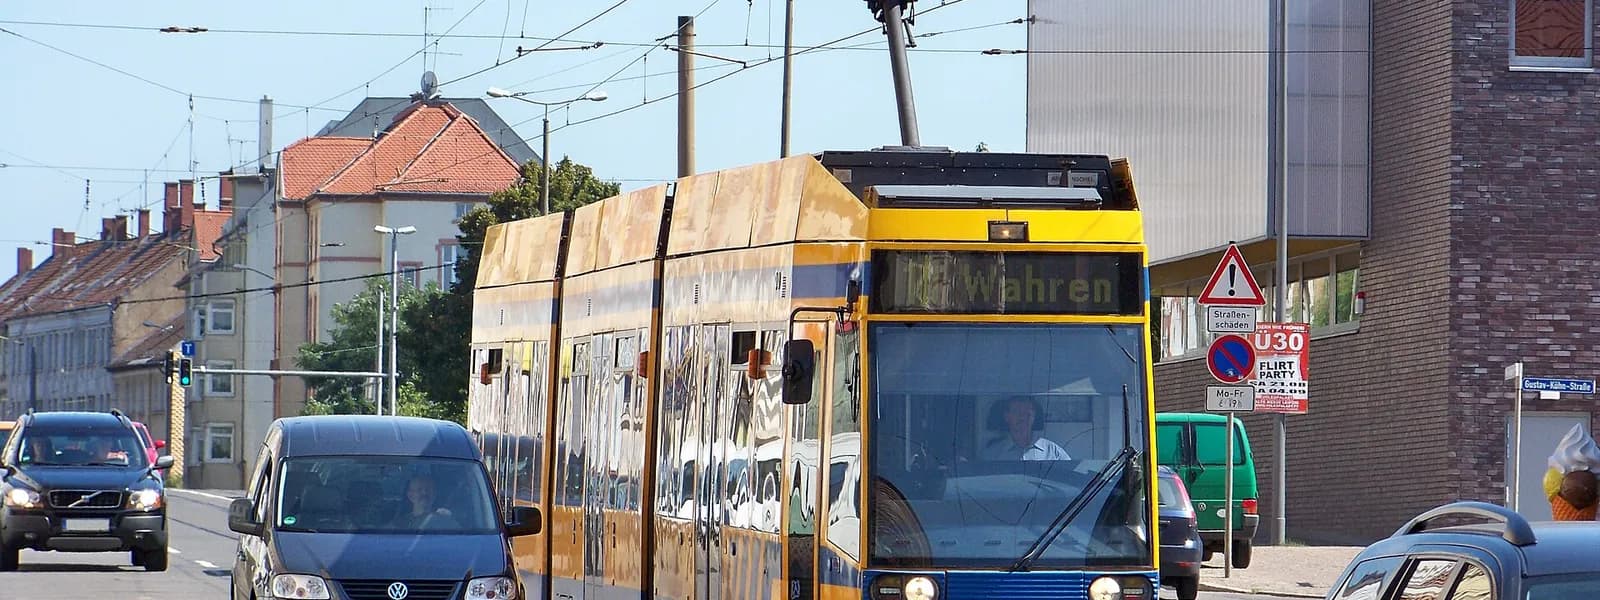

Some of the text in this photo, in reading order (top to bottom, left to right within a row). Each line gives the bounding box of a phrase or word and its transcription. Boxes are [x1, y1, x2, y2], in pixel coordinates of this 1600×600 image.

[961, 261, 1112, 304] Wahren
[1214, 310, 1250, 319] Straßen-
[1255, 330, 1304, 351] Ü30
[1259, 361, 1295, 371] FLIRT
[1259, 370, 1296, 379] PARTY
[1216, 389, 1245, 398] Mo-Fr
